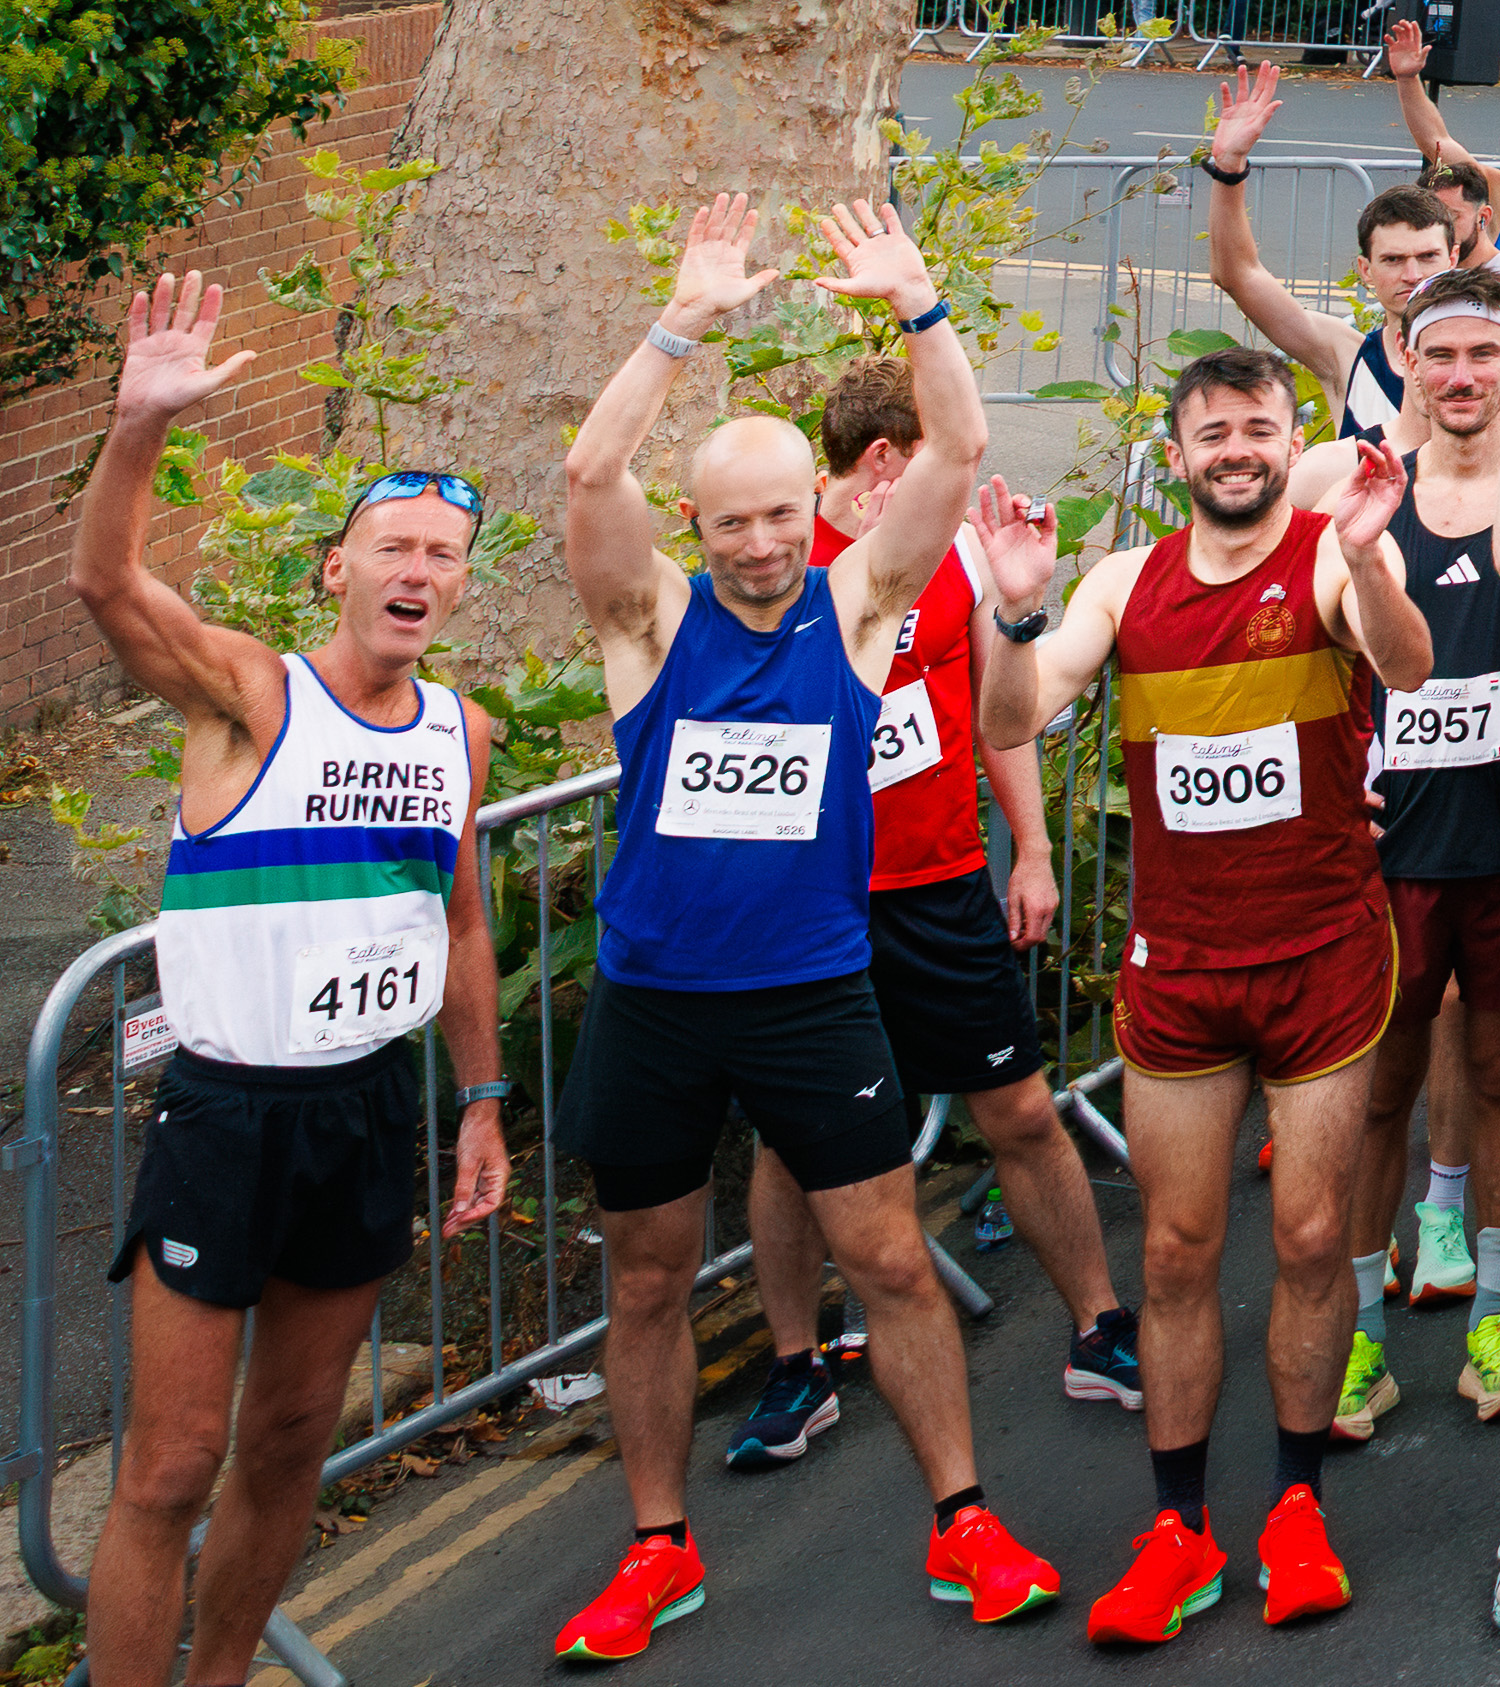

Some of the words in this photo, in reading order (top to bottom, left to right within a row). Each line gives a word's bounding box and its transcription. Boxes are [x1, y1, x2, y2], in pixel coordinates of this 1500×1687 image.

[721, 727, 788, 748] Ealing
[867, 712, 925, 770] 31
[1396, 703, 1491, 745] 2957
[1191, 742, 1253, 758] Ealing
[323, 760, 445, 792] BARNES
[682, 752, 810, 796] 3526
[1170, 758, 1286, 806] 3906
[775, 825, 806, 836] 3526
[309, 961, 420, 1020] 4161
